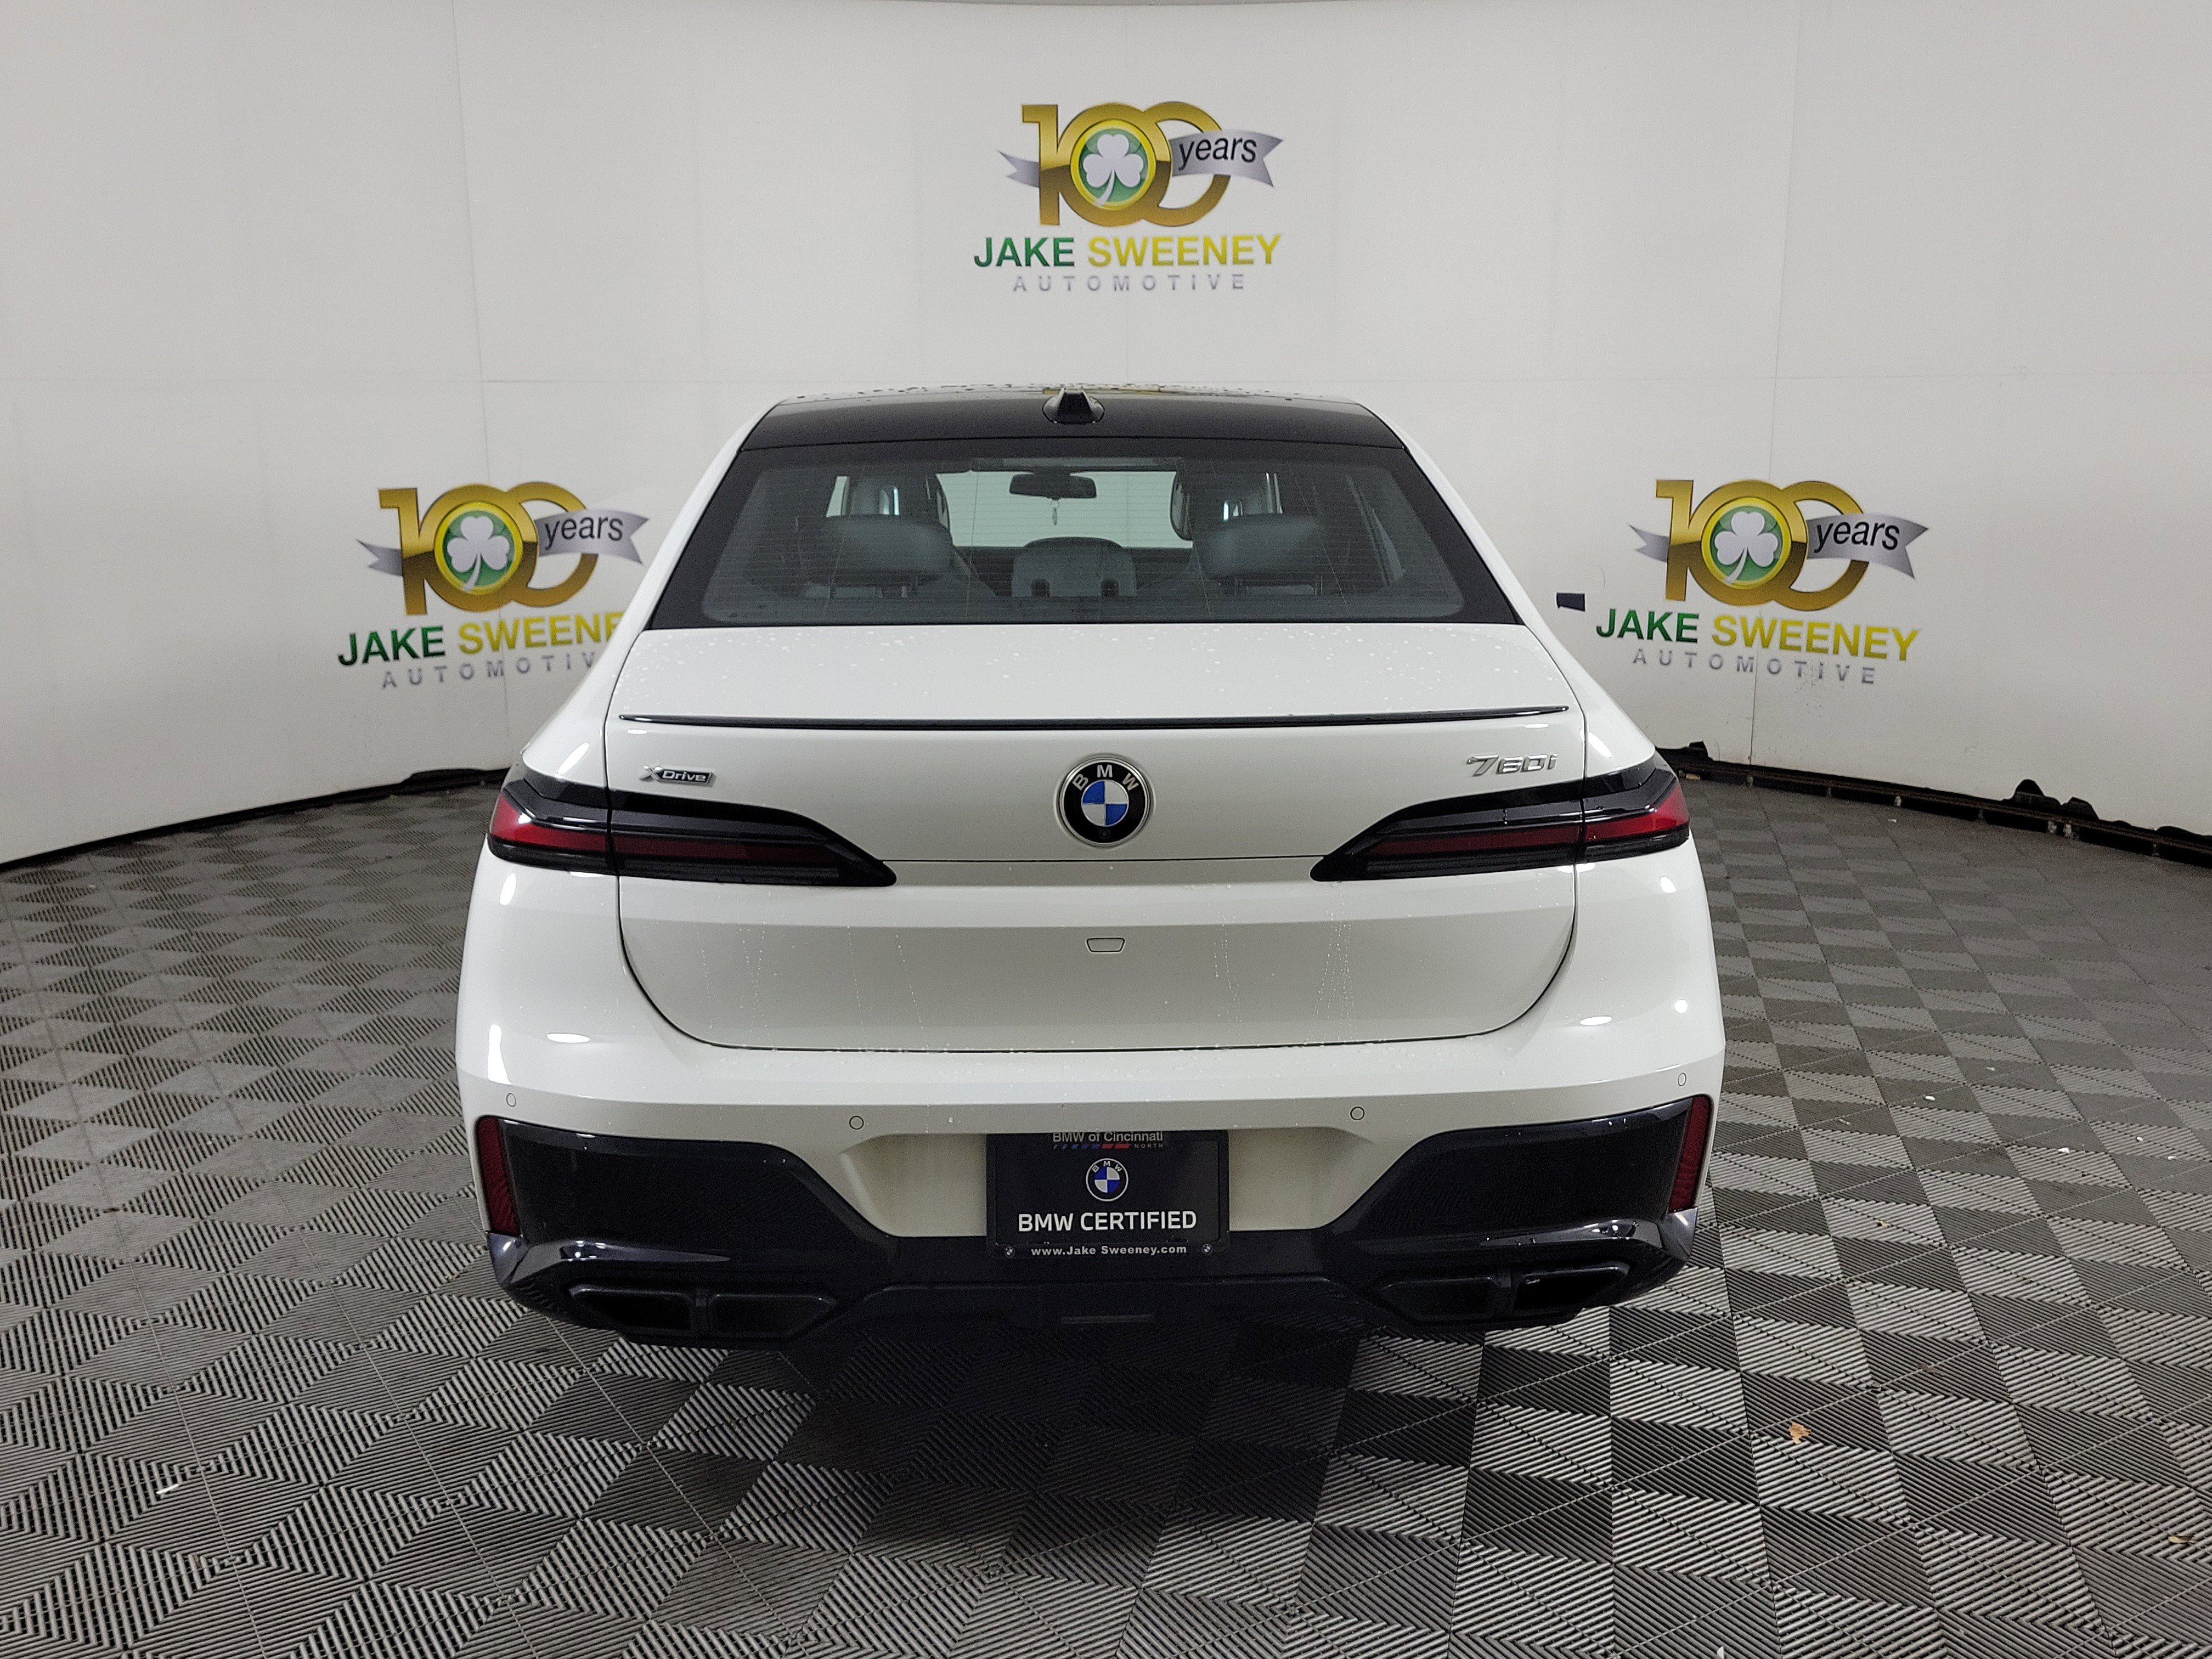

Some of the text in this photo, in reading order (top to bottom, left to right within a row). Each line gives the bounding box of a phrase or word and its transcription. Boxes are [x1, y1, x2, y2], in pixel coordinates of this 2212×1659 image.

[1178, 137, 1257, 171] years
[974, 234, 1283, 267] JAKE SWEENEY
[1013, 274, 1244, 291] AUTOMOTIVE
[544, 515, 624, 550] years
[1814, 520, 1901, 554] years
[337, 625, 446, 667] JAKE
[1595, 608, 1919, 662] JAKE SWEENEY
[381, 651, 595, 690] AUTOMOTIV
[1632, 649, 1875, 685] AUTOMOTIVE
[1072, 764, 1139, 791] BMW
[1466, 753, 1558, 777] 760i
[1053, 1131, 1163, 1142] BMW of Cincinnati
[1092, 1160, 1122, 1173] BMW
[1018, 1211, 1197, 1232] BMW CERTIFIED
[1031, 1245, 1187, 1256] www.Jake Sweeney.com
